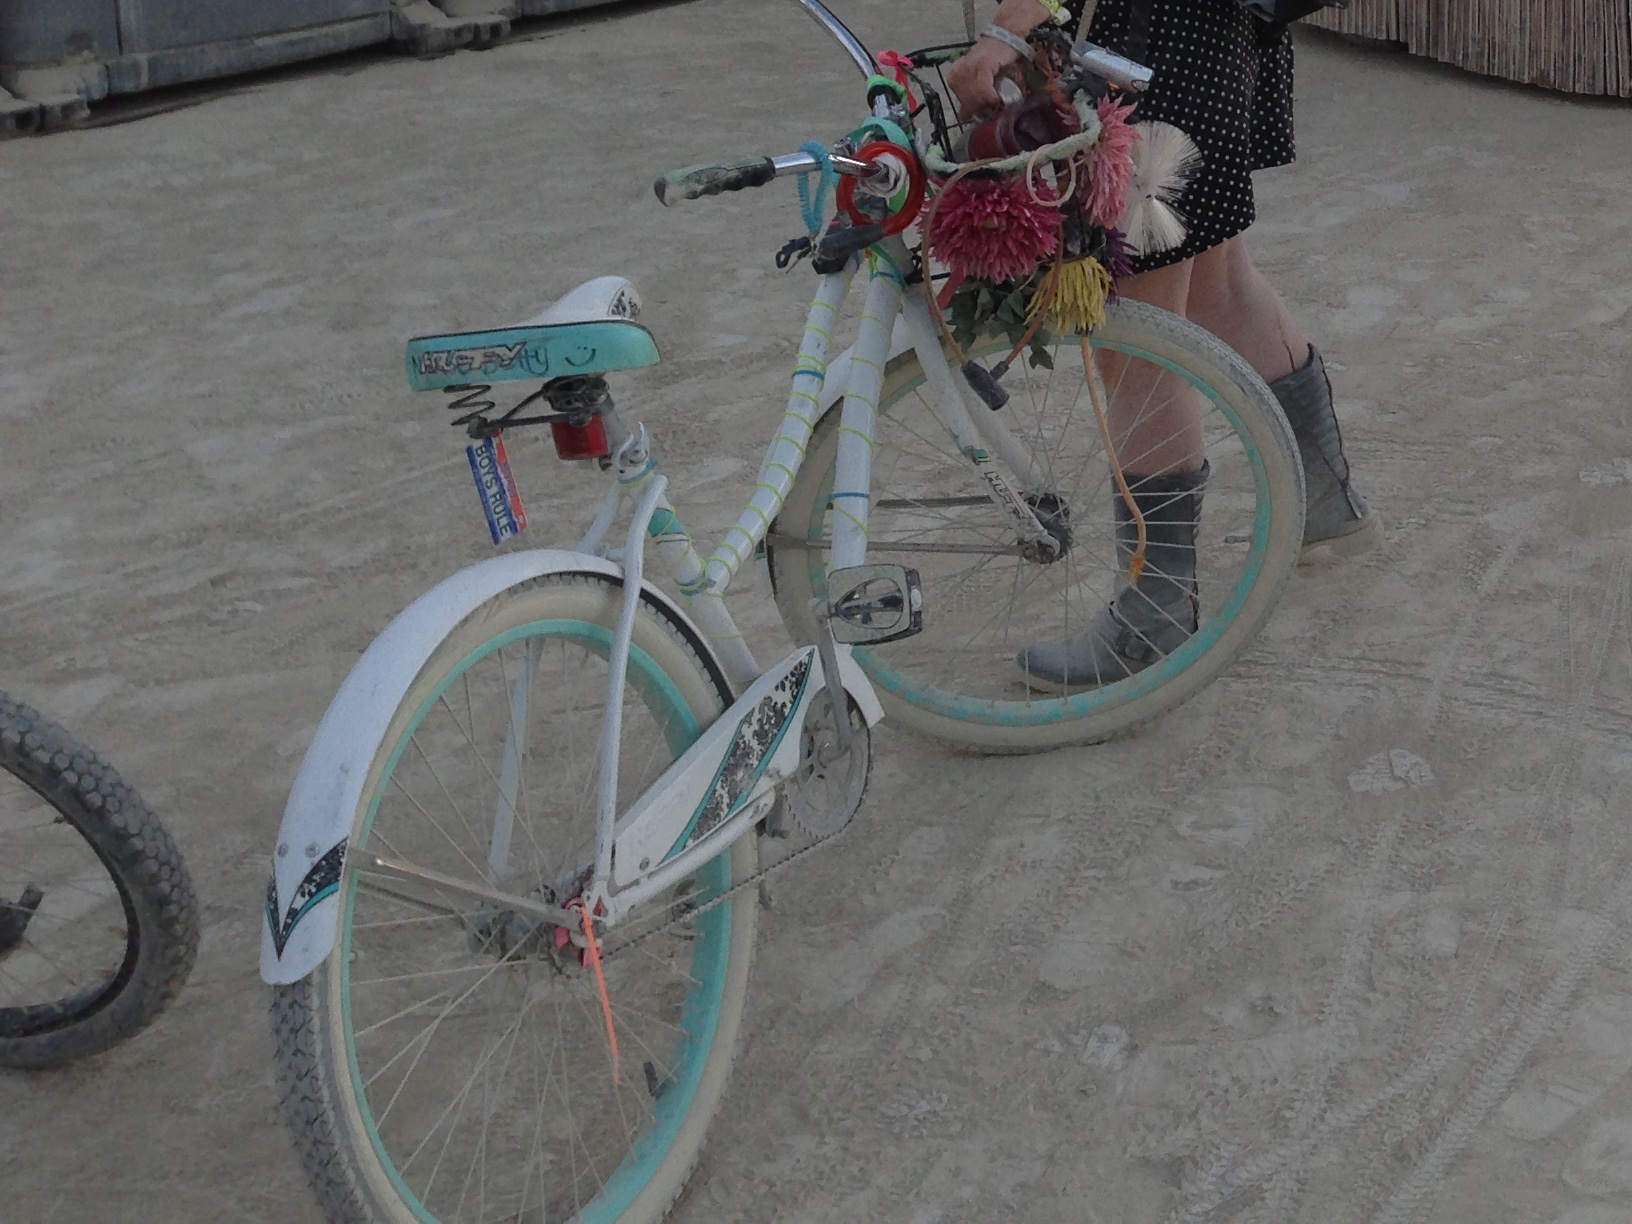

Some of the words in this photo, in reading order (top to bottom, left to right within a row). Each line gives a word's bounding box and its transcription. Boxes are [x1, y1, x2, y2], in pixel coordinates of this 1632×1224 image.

[420, 341, 527, 375] HUFFY
[475, 444, 498, 490] BOYS
[489, 492, 512, 537] RULE
